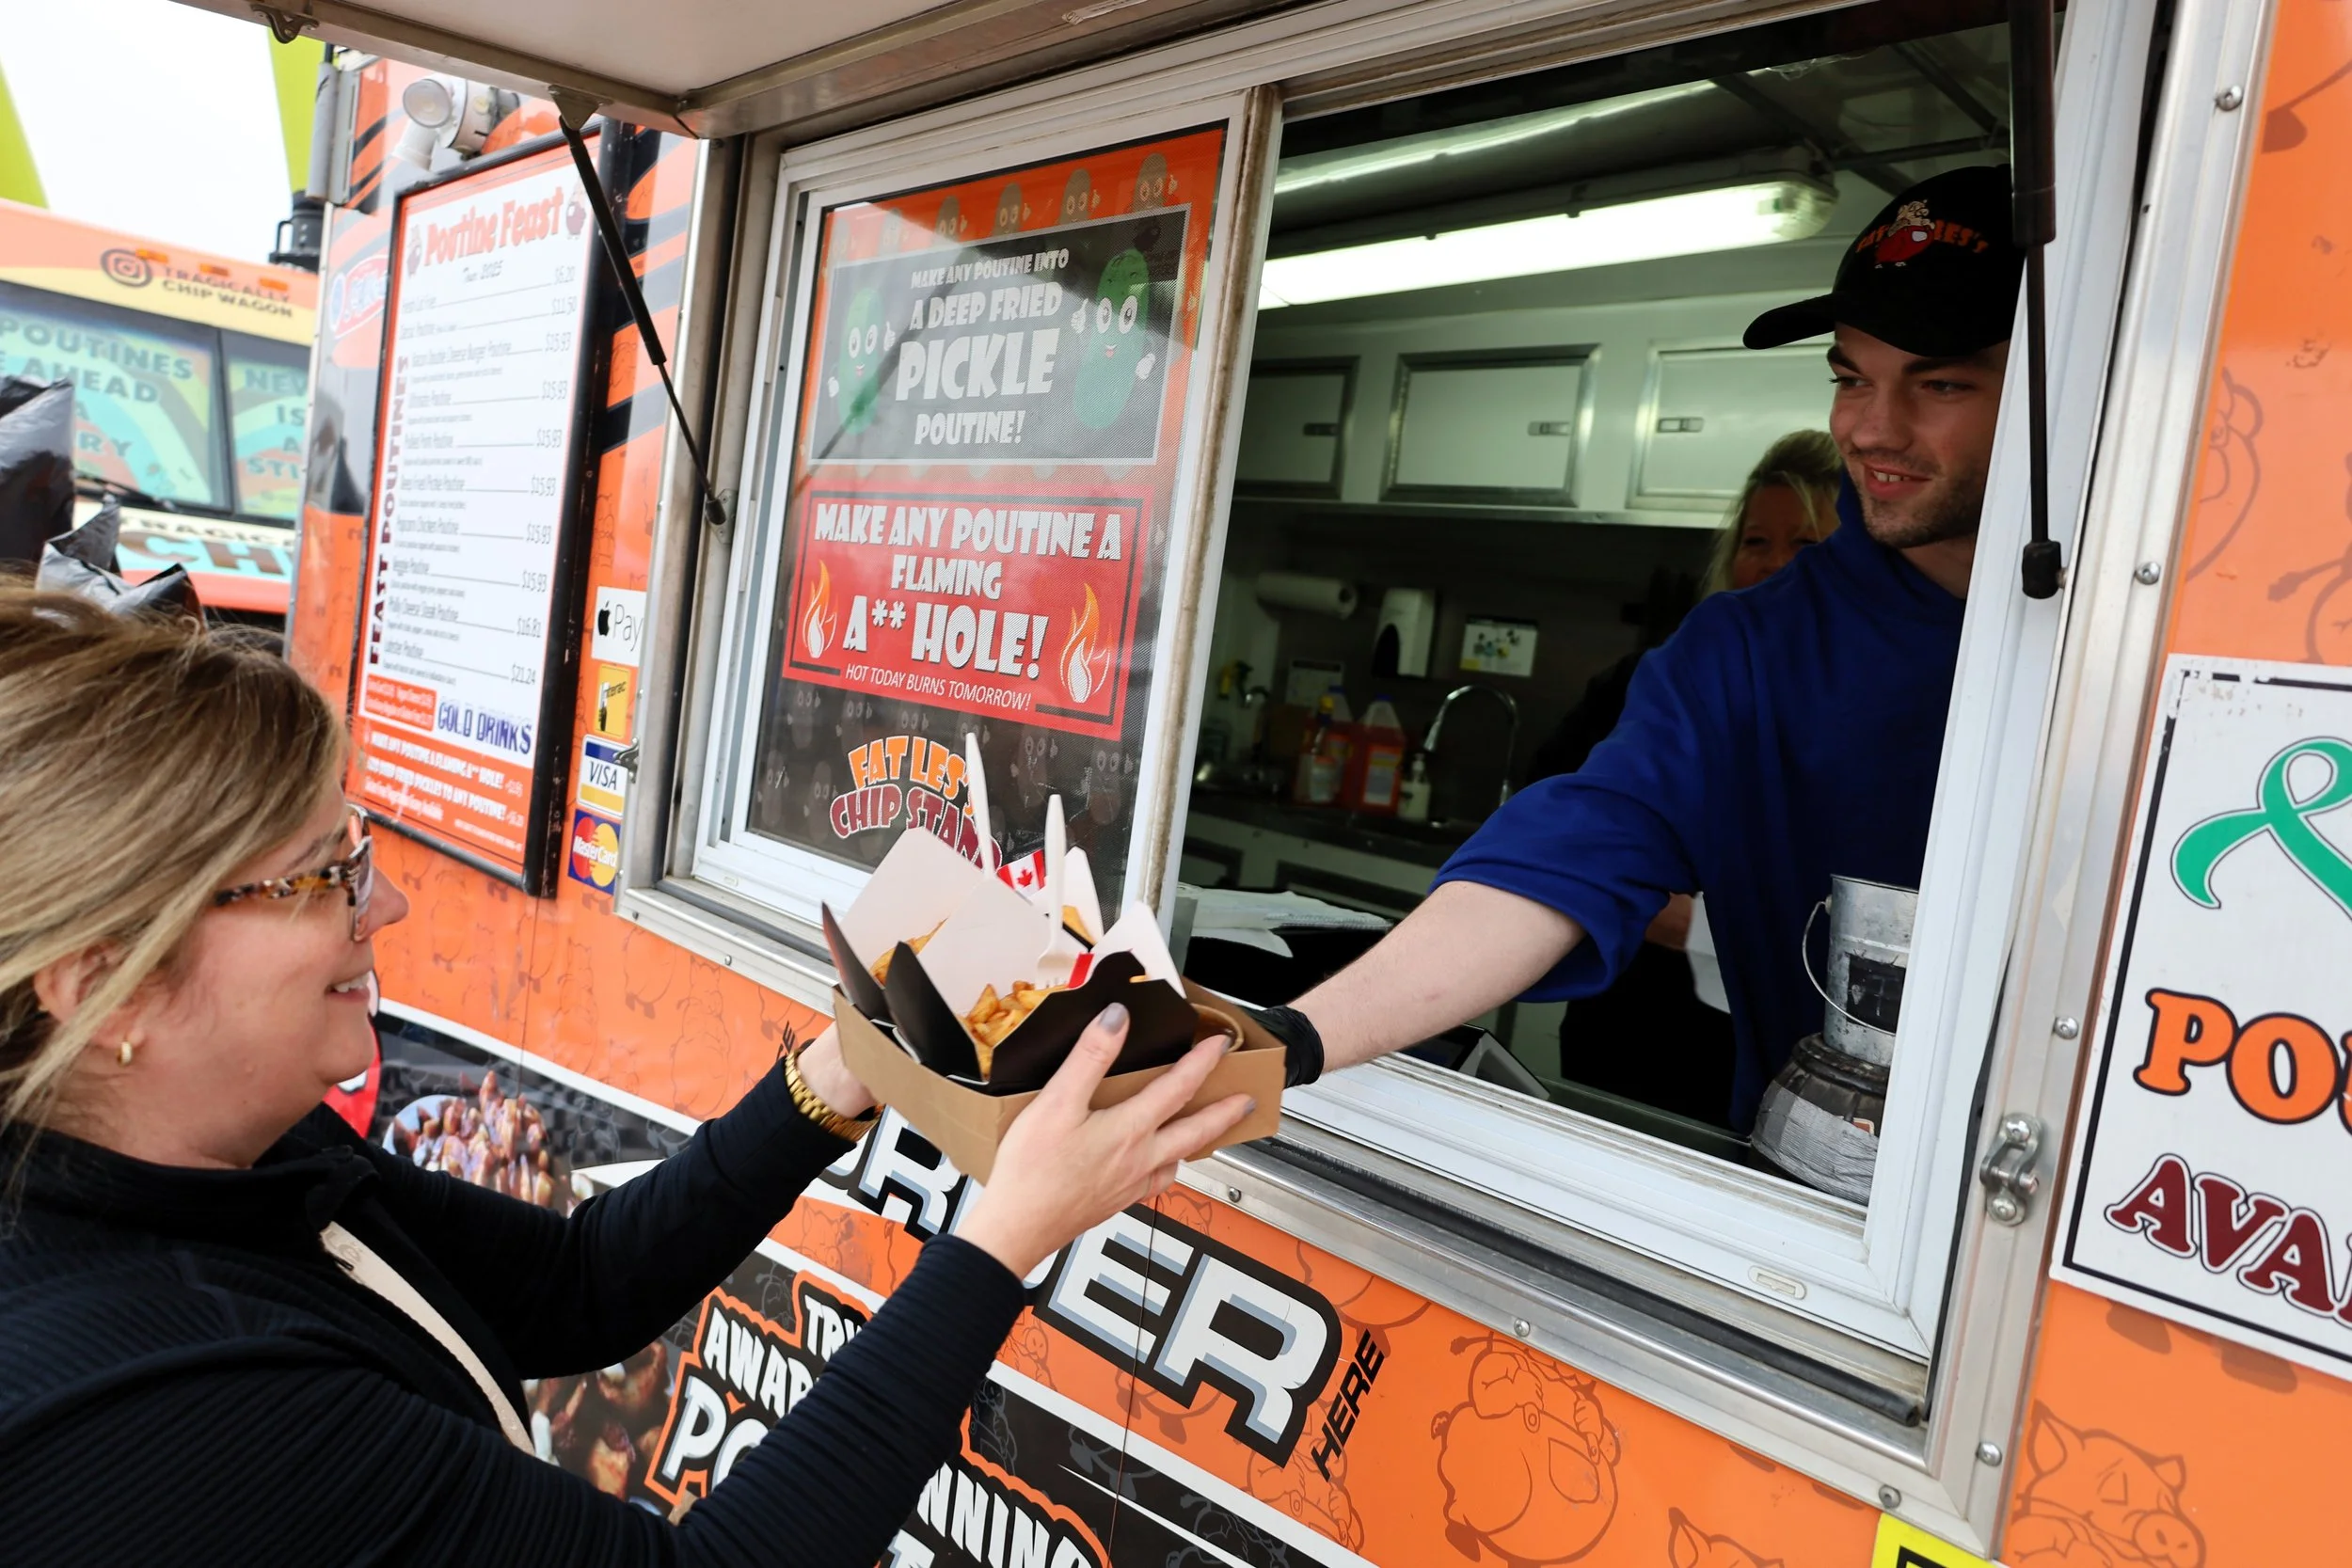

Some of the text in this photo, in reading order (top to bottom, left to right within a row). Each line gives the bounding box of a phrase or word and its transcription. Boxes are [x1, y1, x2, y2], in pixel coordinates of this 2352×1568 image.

[499, 185, 564, 248] Feast
[165, 267, 290, 304] TRAGICALLY
[911, 247, 1070, 290] MAKE ANY POUTINE INTO
[163, 279, 294, 318] CHIP WAGON
[909, 281, 1063, 331] A DEEP FRIED
[545, 332, 572, 354] $15.93
[895, 326, 1061, 402] PICKLE
[22, 356, 160, 404] AHEAD
[542, 380, 569, 401] $15.93
[536, 429, 563, 449] $15.93
[914, 410, 1026, 447] POUTINE!
[531, 475, 557, 497] $15.93
[525, 521, 552, 545] $15.93
[814, 502, 1122, 562] MAKE ANY POUTINE A
[522, 568, 548, 594] $15.93
[890, 553, 1003, 600] FLAMING
[612, 603, 644, 652] Pay
[910, 600, 1049, 680] HOLE!
[510, 661, 537, 686] $21.24
[845, 662, 1032, 711] HOT TODAY BURNS TOMORROW!
[437, 700, 473, 738] COLD
[475, 710, 533, 755] DRINKS
[589, 760, 618, 791] VISA
[848, 735, 976, 817] FAT LES'
[829, 783, 903, 839] CHIP
[573, 834, 618, 868] MasterCard
[2133, 988, 2352, 1136] PO
[2105, 1153, 2352, 1332] AVA
[825, 1103, 1330, 1446] RER
[703, 1307, 820, 1420] AWAR
[1310, 1330, 1386, 1483] HERE
